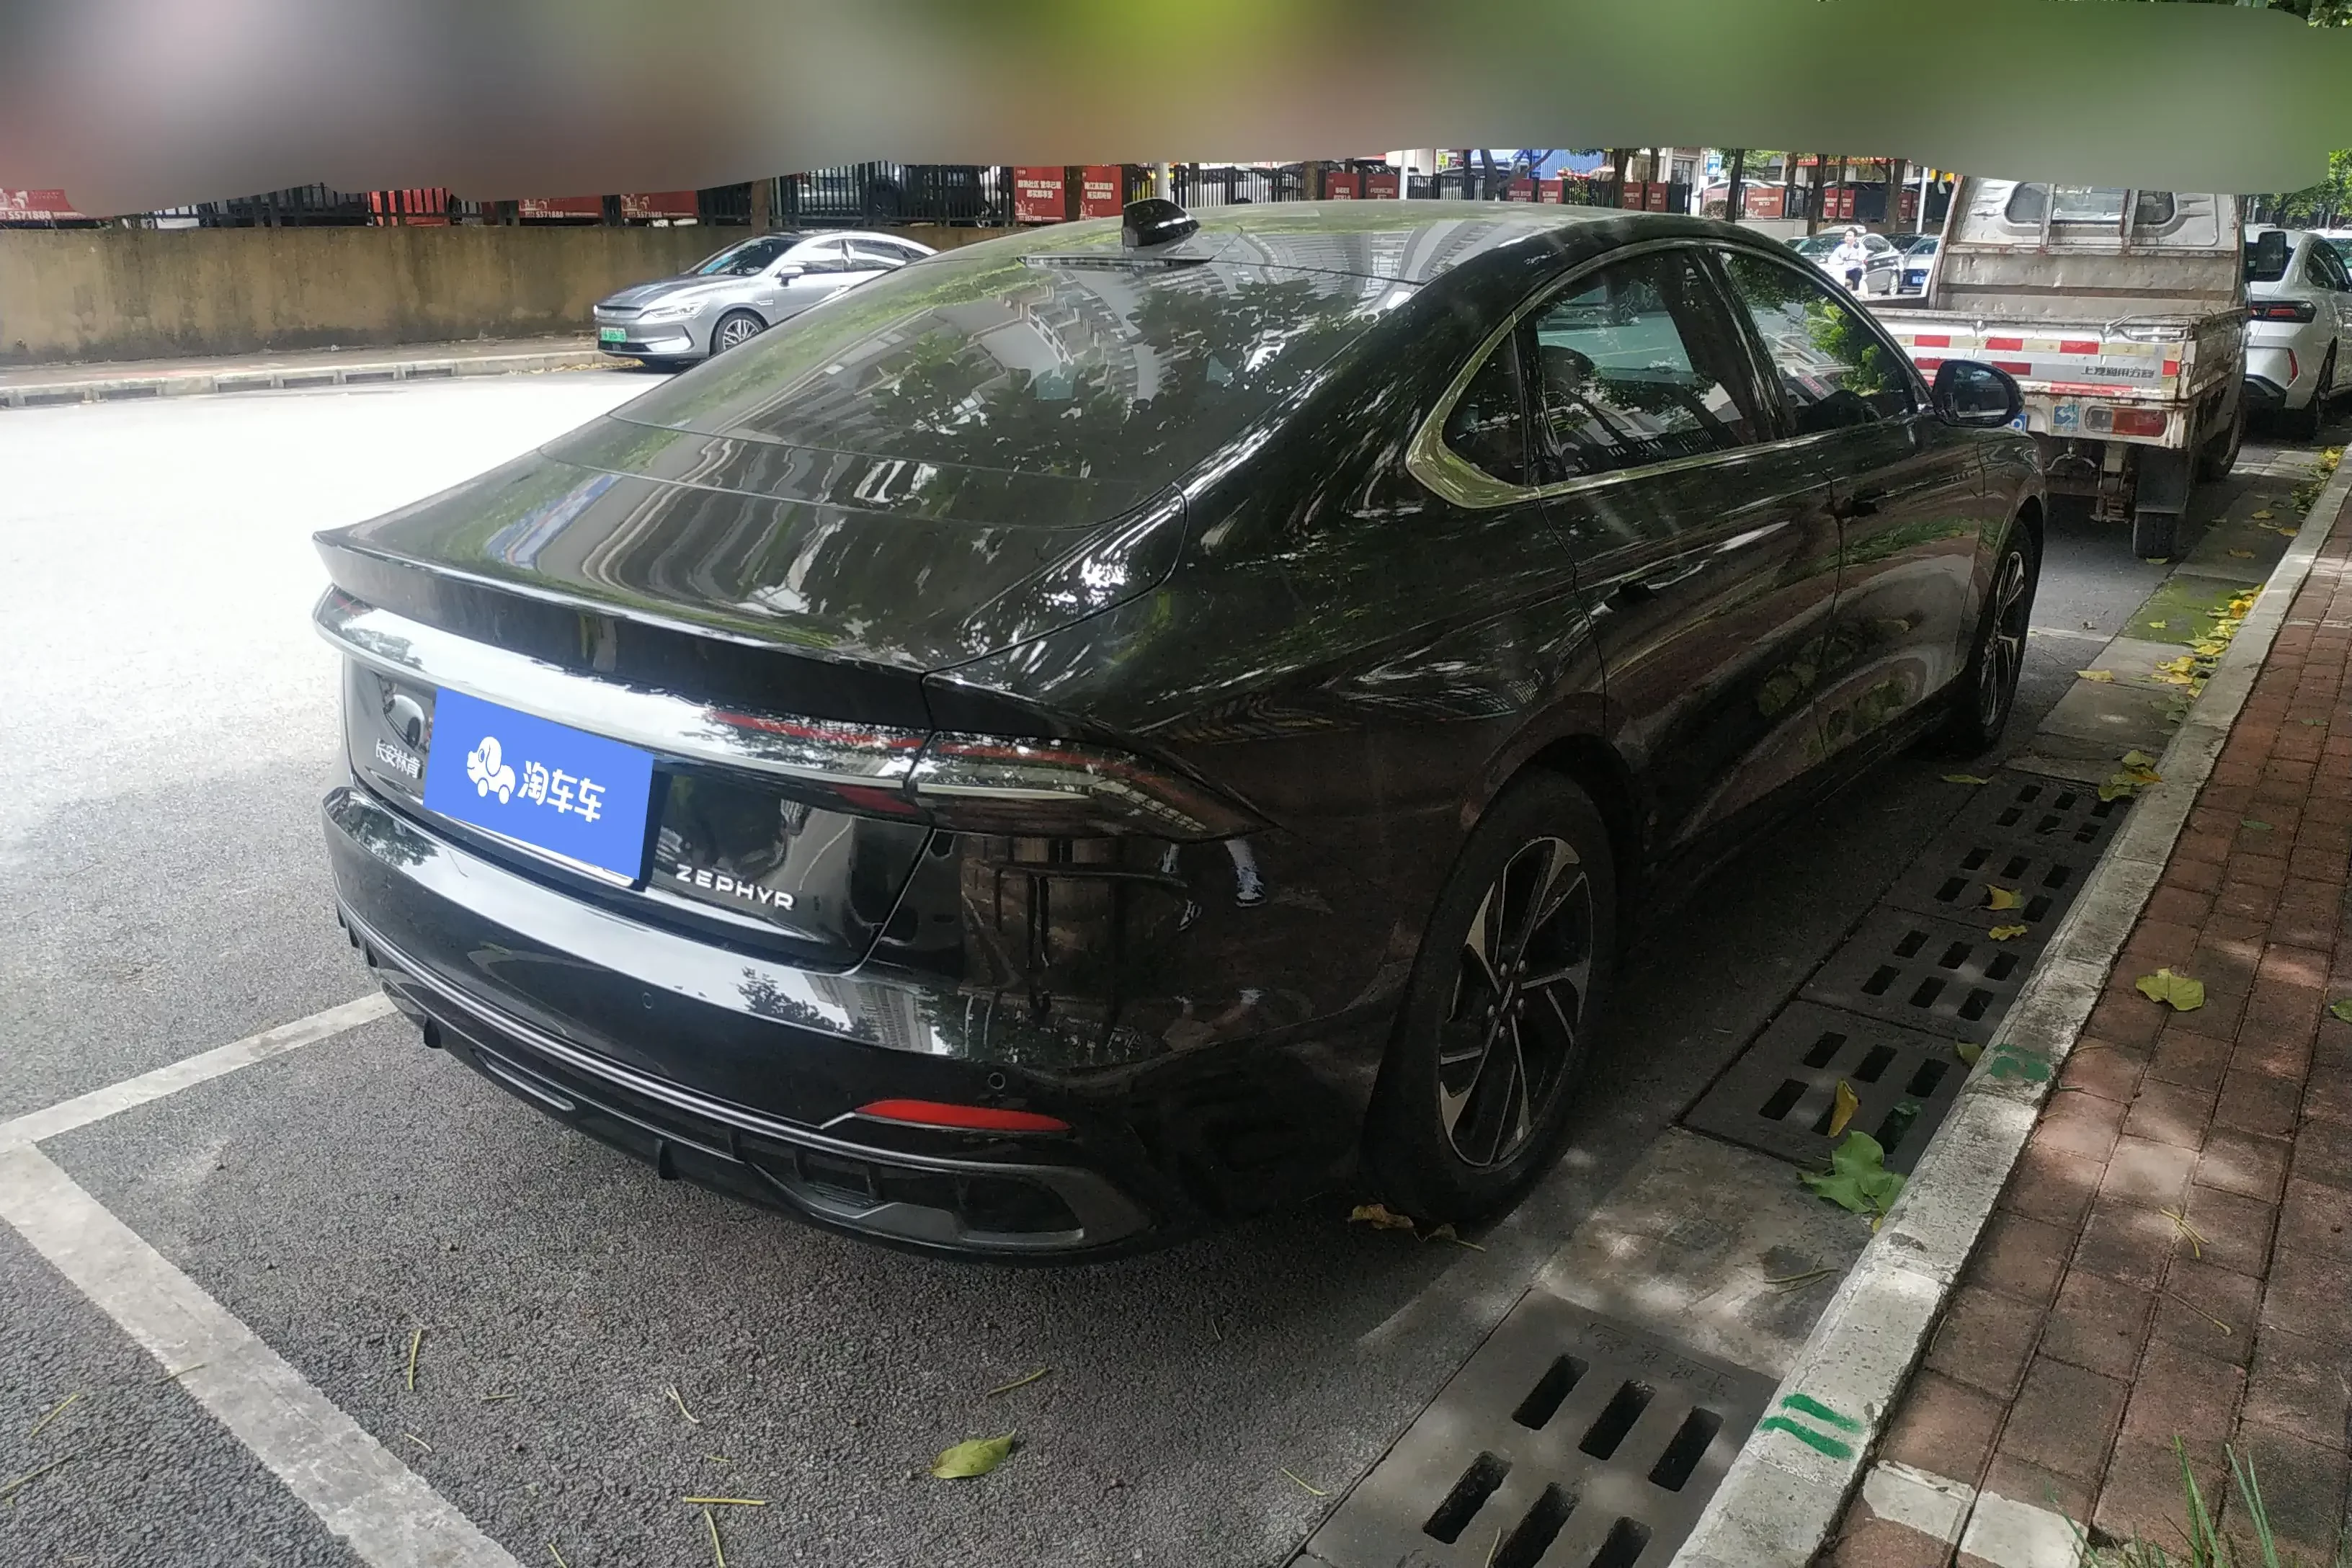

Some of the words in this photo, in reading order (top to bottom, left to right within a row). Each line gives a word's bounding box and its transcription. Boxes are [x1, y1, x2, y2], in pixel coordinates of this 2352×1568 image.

[2081, 365, 2155, 378] 上汽通用五菱
[375, 738, 420, 778] 长安林肯
[676, 864, 794, 911] ZEPHYR
